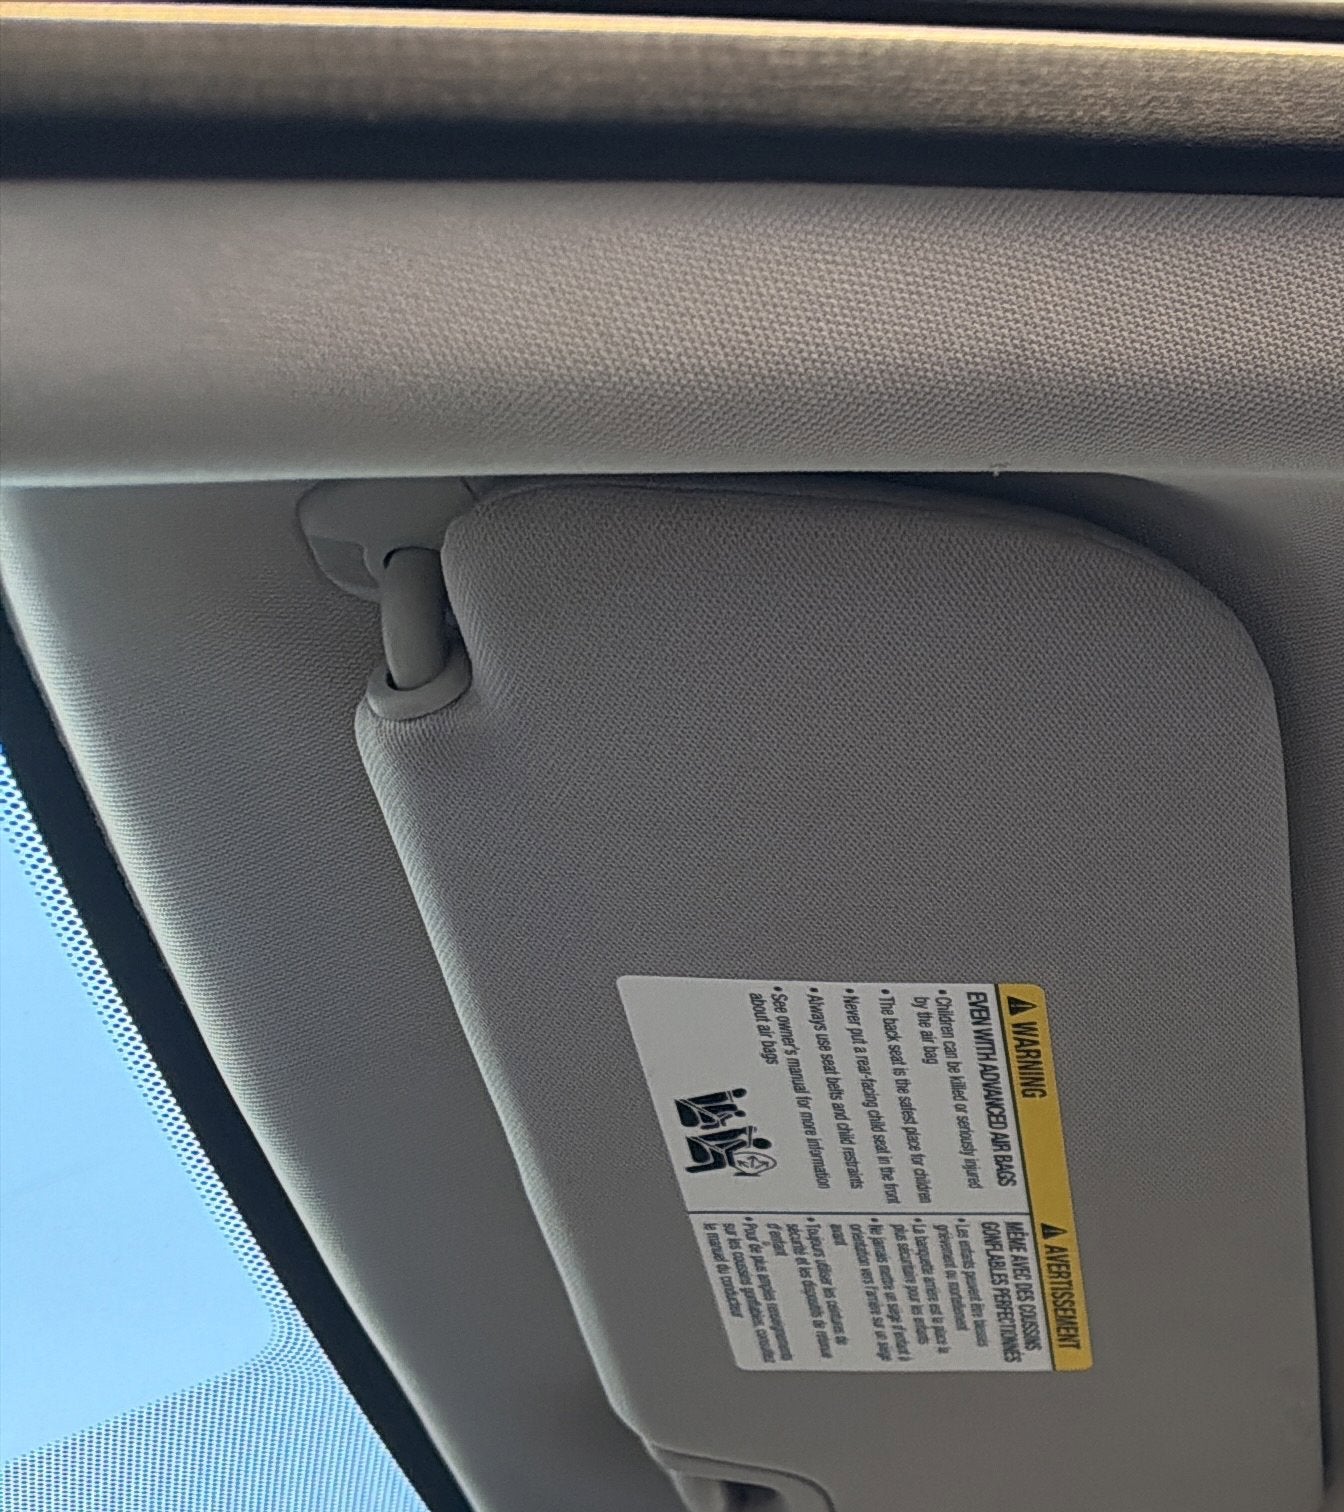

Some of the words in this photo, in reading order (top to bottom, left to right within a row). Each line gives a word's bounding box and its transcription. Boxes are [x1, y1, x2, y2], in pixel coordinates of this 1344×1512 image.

[748, 992, 773, 1023] about
[770, 993, 789, 1014] See
[805, 993, 828, 1032] Always
[842, 995, 862, 1027] Never
[878, 995, 897, 1016] The
[910, 996, 931, 1010] by
[966, 991, 993, 1026] EVEN
[915, 1011, 935, 1029] the
[934, 996, 956, 1039] Children
[756, 1024, 776, 1039] air
[774, 1015, 801, 1056] owner's
[844, 1027, 869, 1045] put
[882, 1017, 903, 1043] back
[919, 1030, 938, 1044] air
[760, 1040, 780, 1065] bags
[814, 1033, 833, 1052] use
[852, 1046, 868, 1054] a
[942, 1040, 959, 1059] can
[972, 1027, 998, 1062] WITH
[819, 1053, 841, 1076] seat
[887, 1044, 908, 1066] seat
[921, 1045, 940, 1065] bag
[946, 1060, 963, 1074] be
[1010, 1021, 1048, 1099] WARNING
[786, 1057, 811, 1095] manual
[854, 1055, 880, 1108] rear-facing
[892, 1067, 909, 1077] is
[825, 1076, 845, 1101] belts
[894, 1078, 912, 1095] the
[948, 1075, 969, 1102] killed
[978, 1062, 1009, 1130] ADVANCED
[795, 1095, 813, 1111] for
[831, 1102, 852, 1121] and
[897, 1095, 919, 1125] safest
[953, 1103, 969, 1114] or
[798, 1111, 818, 1137] more
[866, 1109, 888, 1133] child
[836, 1122, 857, 1146] child
[871, 1134, 892, 1155] seat
[900, 1126, 922, 1152] place
[955, 1115, 978, 1157] seriously
[988, 1131, 1012, 1153] AIR
[805, 1137, 831, 1190] information
[841, 1146, 865, 1190] restraints
[875, 1155, 894, 1165] in
[909, 1153, 927, 1167] for
[992, 1154, 1017, 1187] BAGS
[878, 1166, 896, 1182] the
[912, 1167, 933, 1204] children
[961, 1158, 984, 1190] injured
[883, 1182, 902, 1205] front
[980, 1220, 1010, 1286] GONFLABLES
[1009, 1253, 1032, 1281] AVEC
[1013, 1282, 1036, 1303] DES
[1043, 1243, 1082, 1350] AVERTISSEMENT
[1017, 1303, 1043, 1352] COUSSINS
